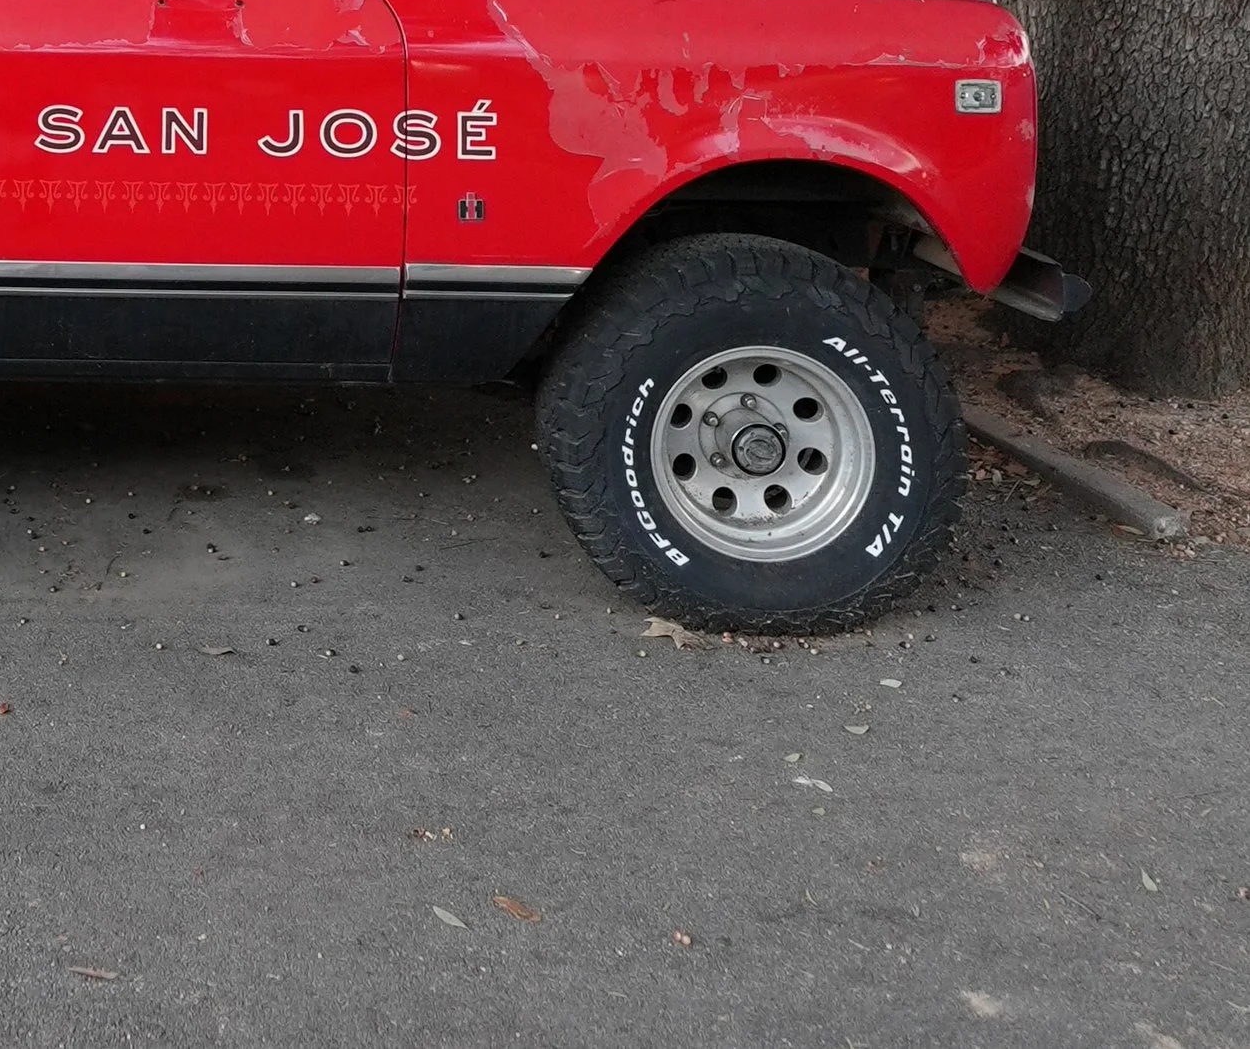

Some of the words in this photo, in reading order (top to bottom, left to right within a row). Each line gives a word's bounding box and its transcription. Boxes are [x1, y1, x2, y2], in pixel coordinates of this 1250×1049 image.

[34, 105, 208, 154] SAN
[258, 99, 498, 161] JOSÉ
[822, 336, 917, 496] All-Terrain
[622, 377, 691, 567] BFGoodrich
[865, 512, 905, 558] T/A
